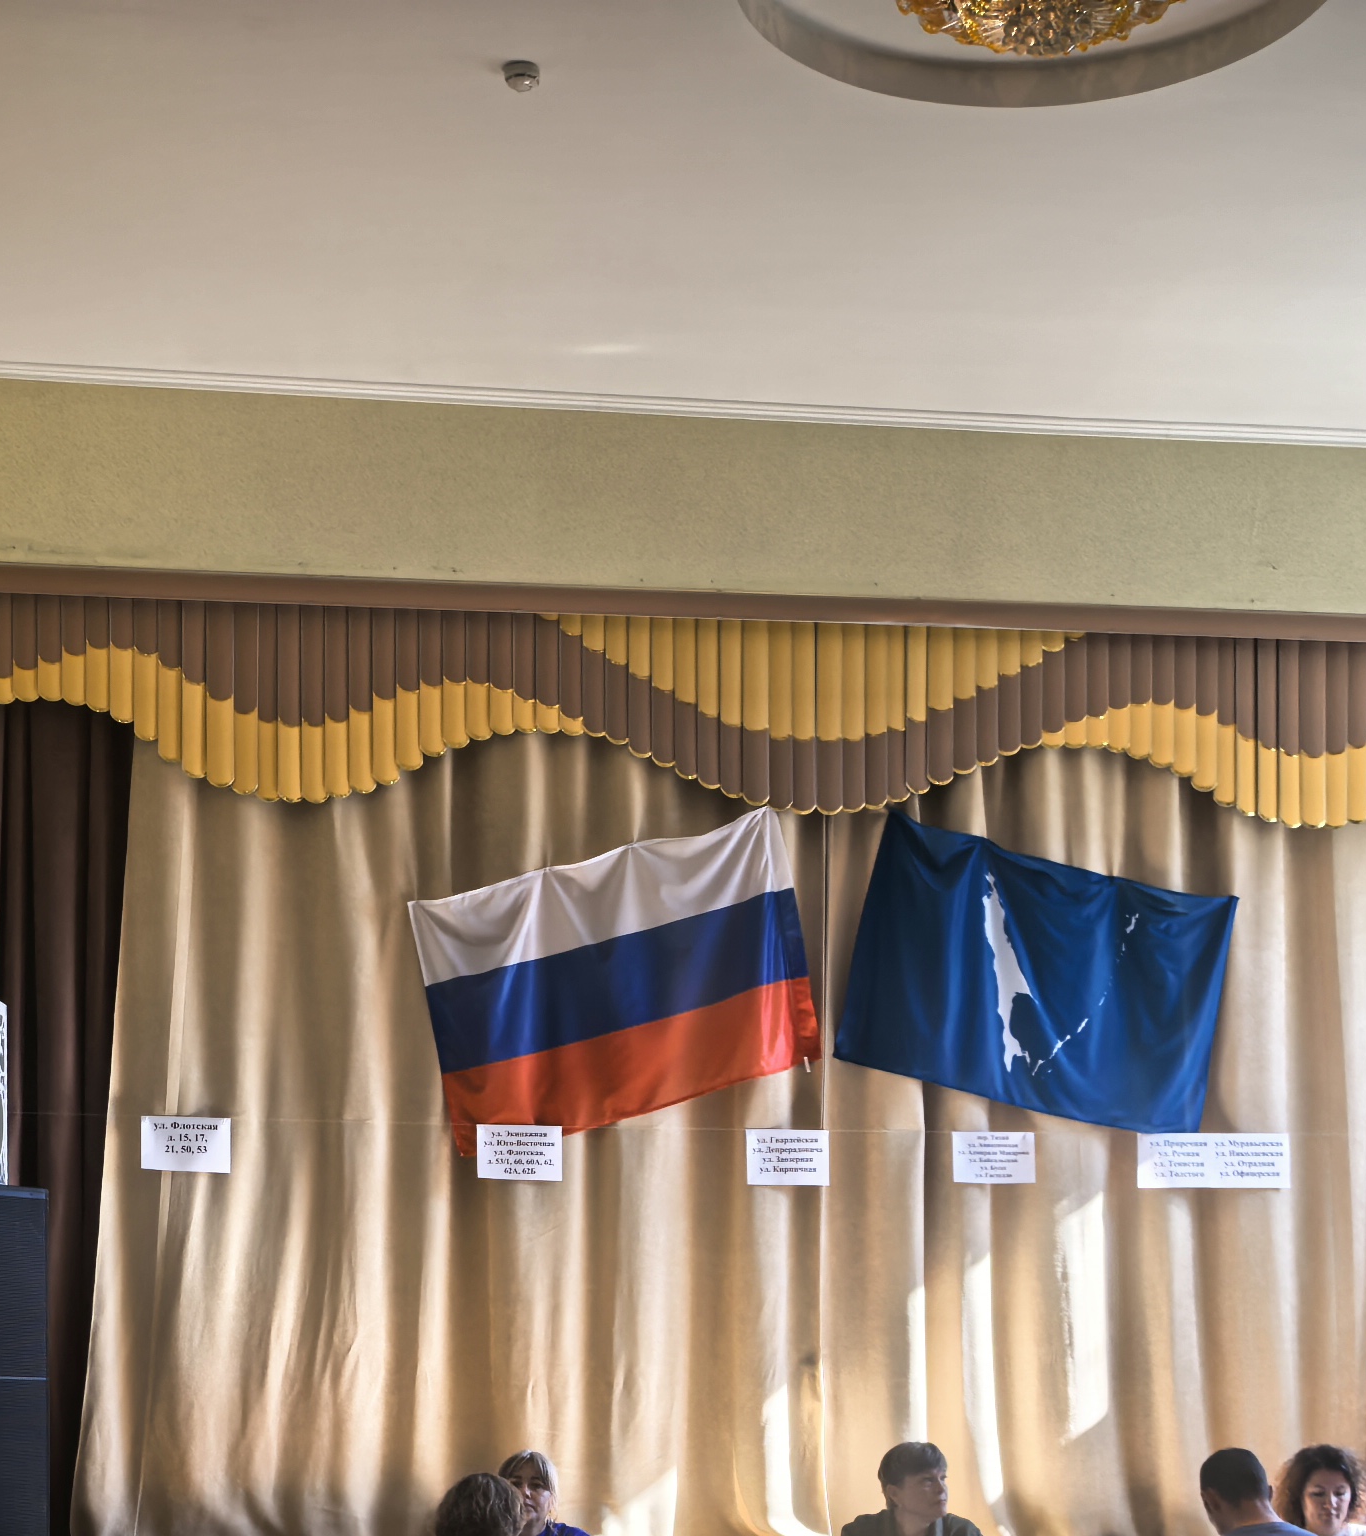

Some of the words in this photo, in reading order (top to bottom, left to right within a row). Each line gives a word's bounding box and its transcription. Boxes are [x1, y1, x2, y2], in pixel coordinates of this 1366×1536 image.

[153, 1122, 168, 1131] ул.
[171, 1121, 218, 1131] Флотская
[179, 1134, 192, 1142] 15,
[195, 1134, 208, 1143] 17,
[165, 1145, 178, 1154] 21,
[181, 1145, 194, 1155] 50,
[197, 1145, 208, 1153] 53
[773, 1166, 816, 1174] Кирпичная
